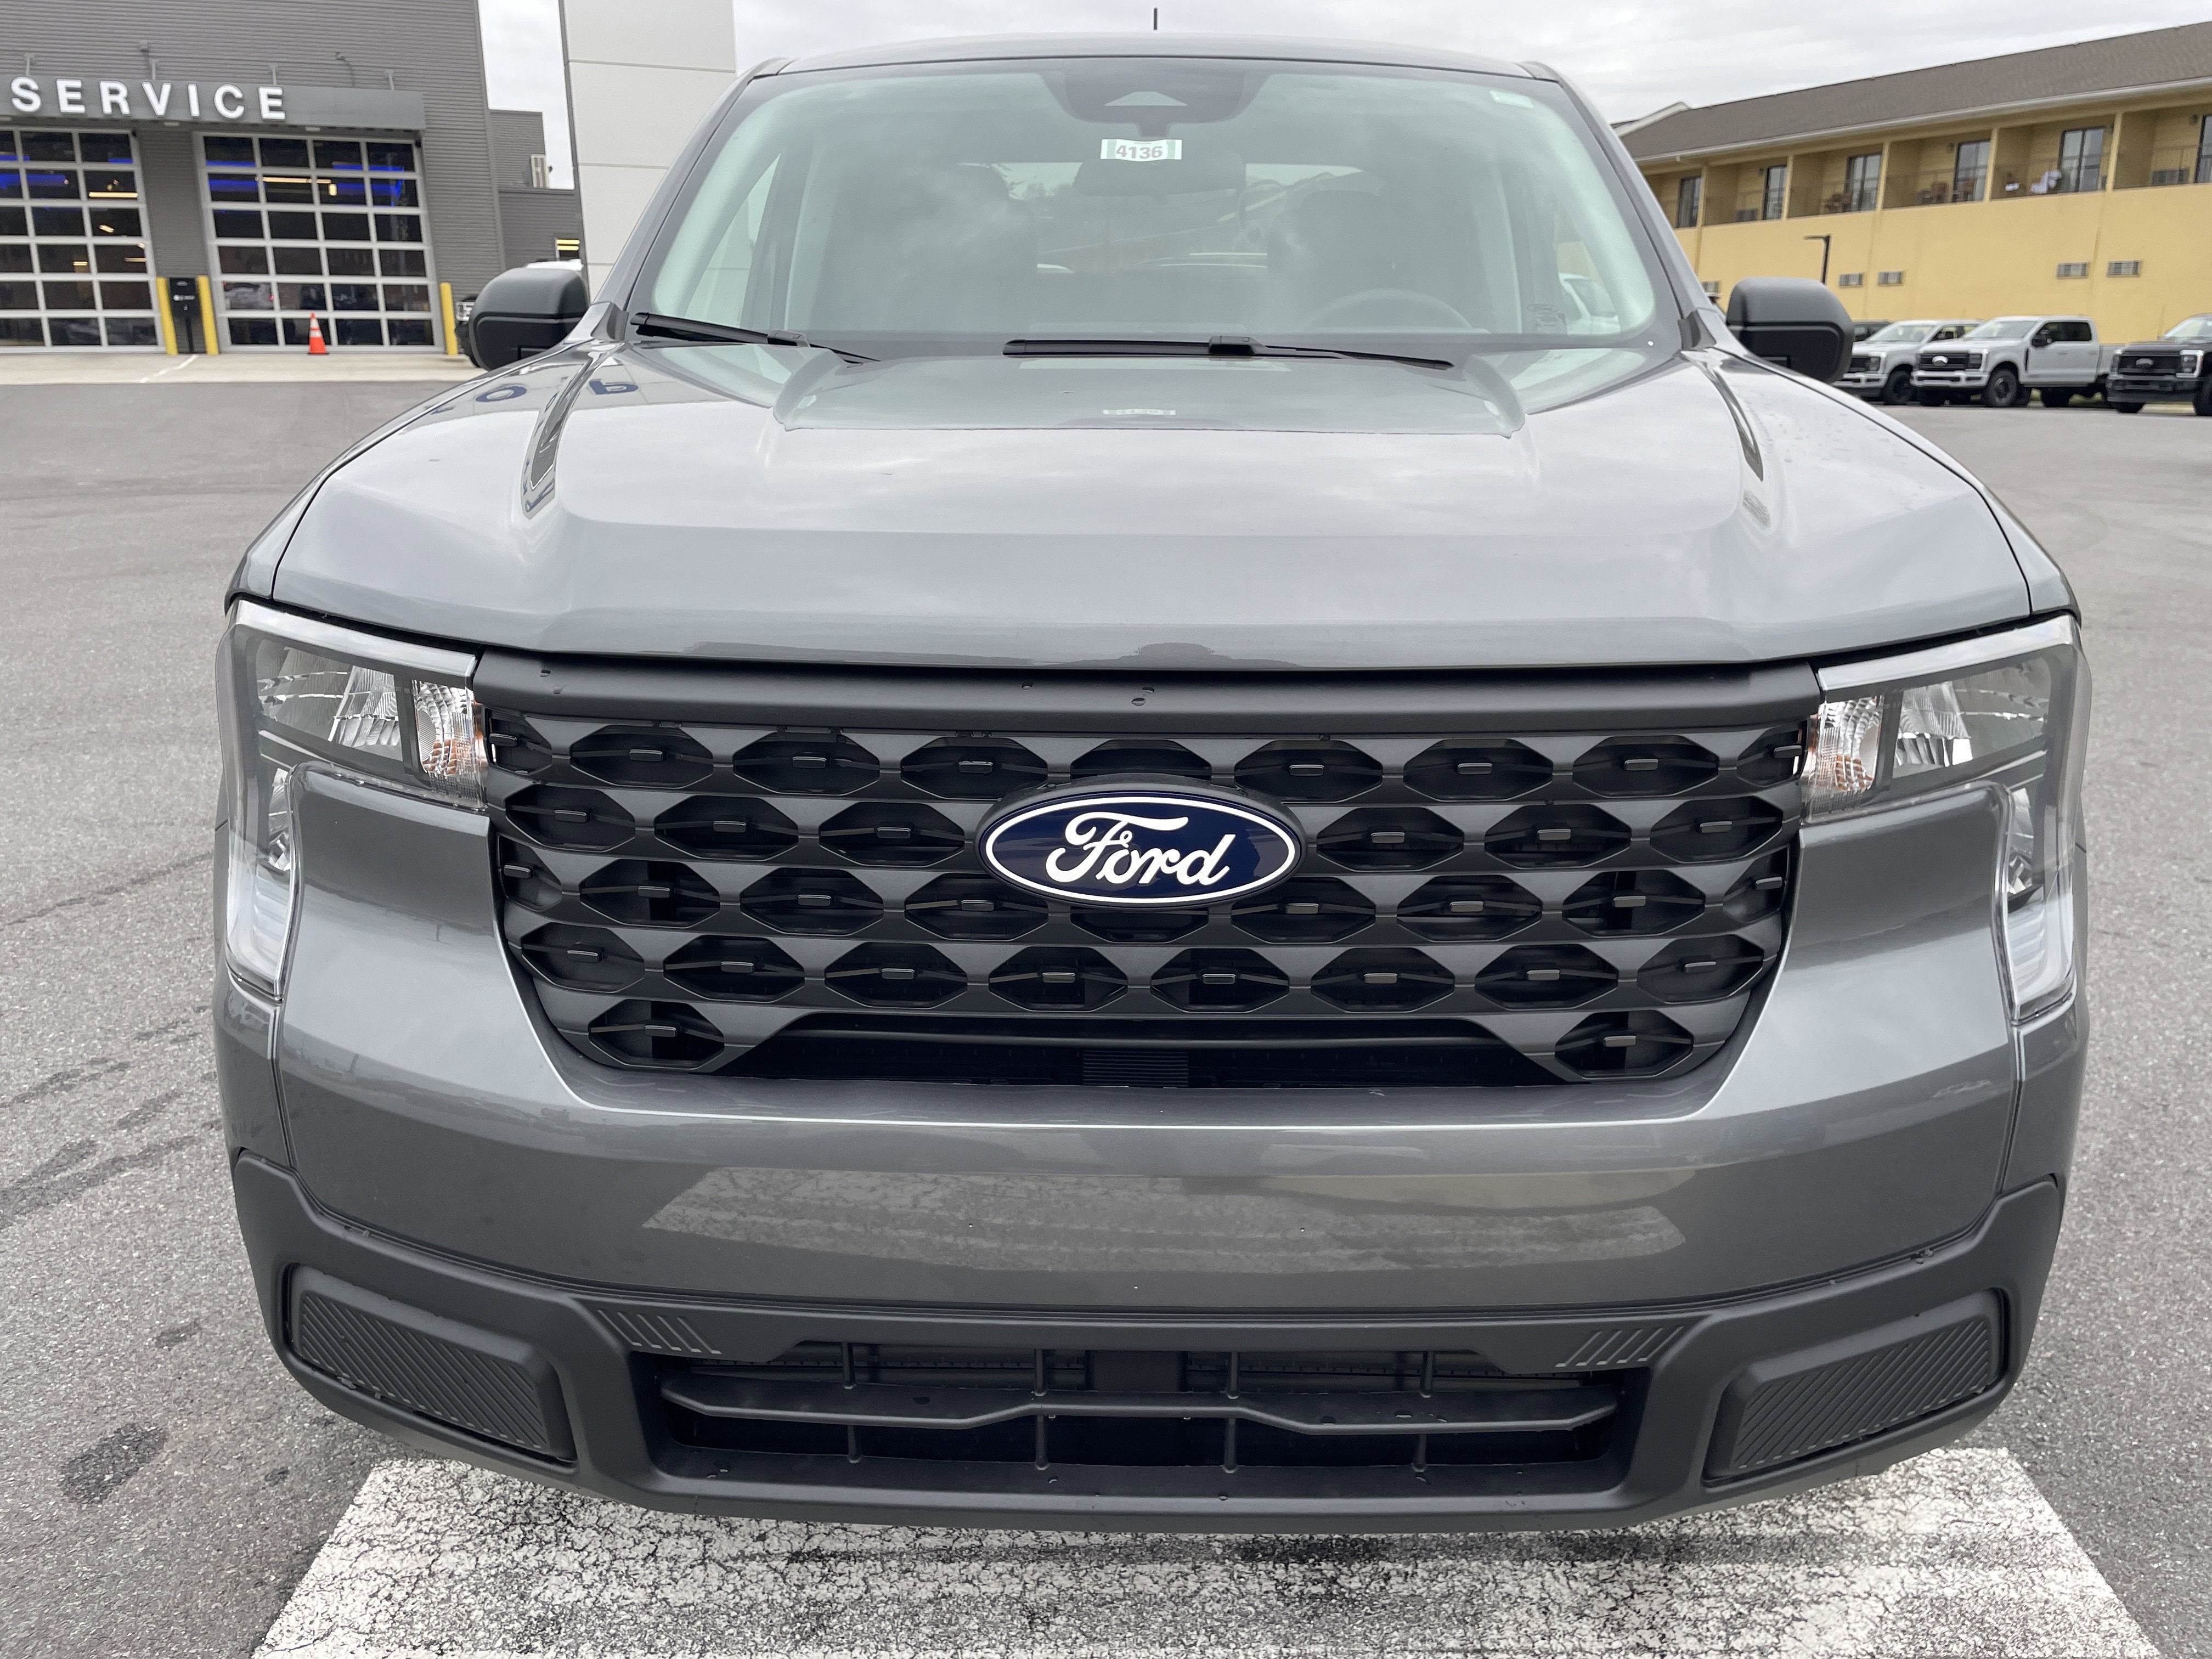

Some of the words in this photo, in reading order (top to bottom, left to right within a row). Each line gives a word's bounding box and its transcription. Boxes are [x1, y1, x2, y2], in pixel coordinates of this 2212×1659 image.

[10, 76, 286, 120] SERVICE
[1116, 145, 1163, 159] 4136
[1046, 812, 1236, 885] Ford
